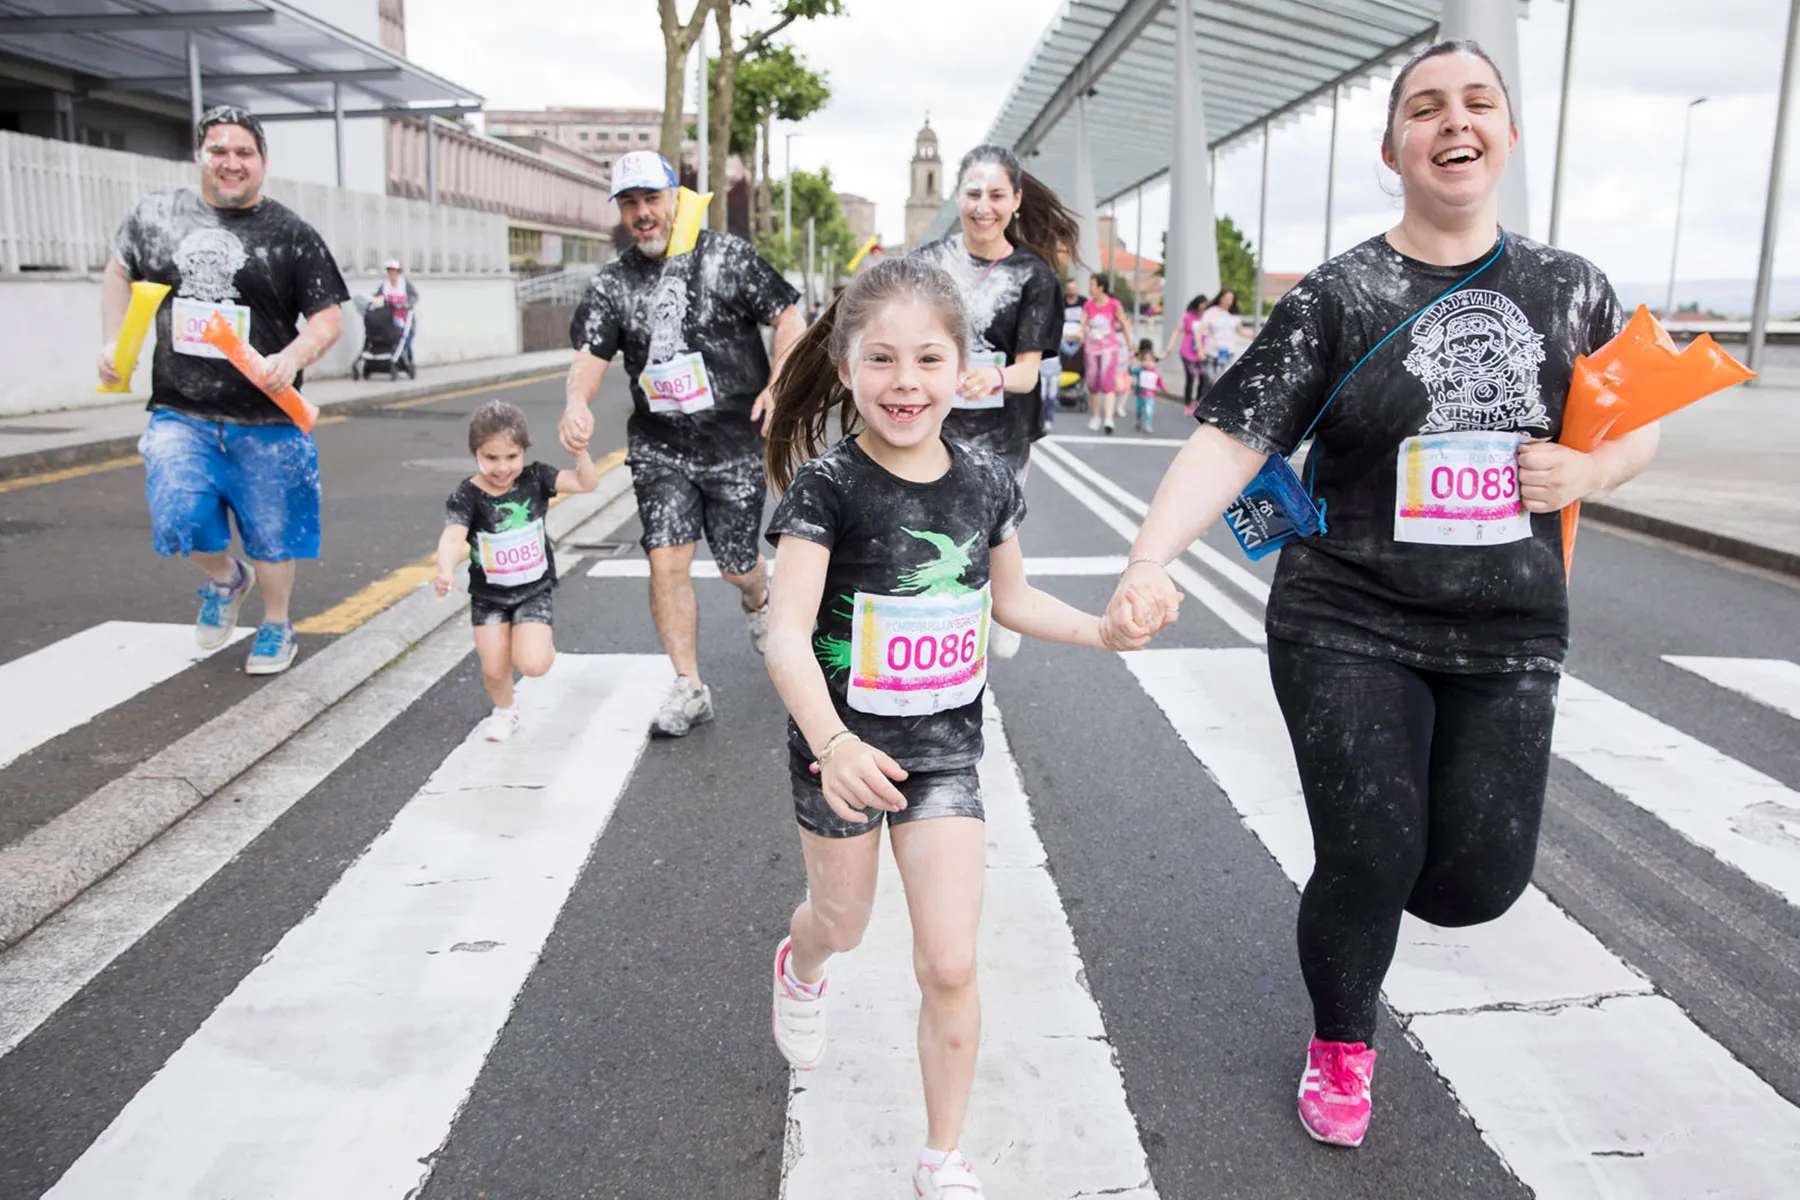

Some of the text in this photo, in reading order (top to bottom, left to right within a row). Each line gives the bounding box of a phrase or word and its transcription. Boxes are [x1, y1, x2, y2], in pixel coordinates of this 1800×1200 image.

[653, 374, 692, 395] 0087
[1438, 406, 1507, 423] FIESTA
[1431, 466, 1516, 501] 0083
[495, 541, 540, 566] 0085
[887, 628, 976, 671] 0086
